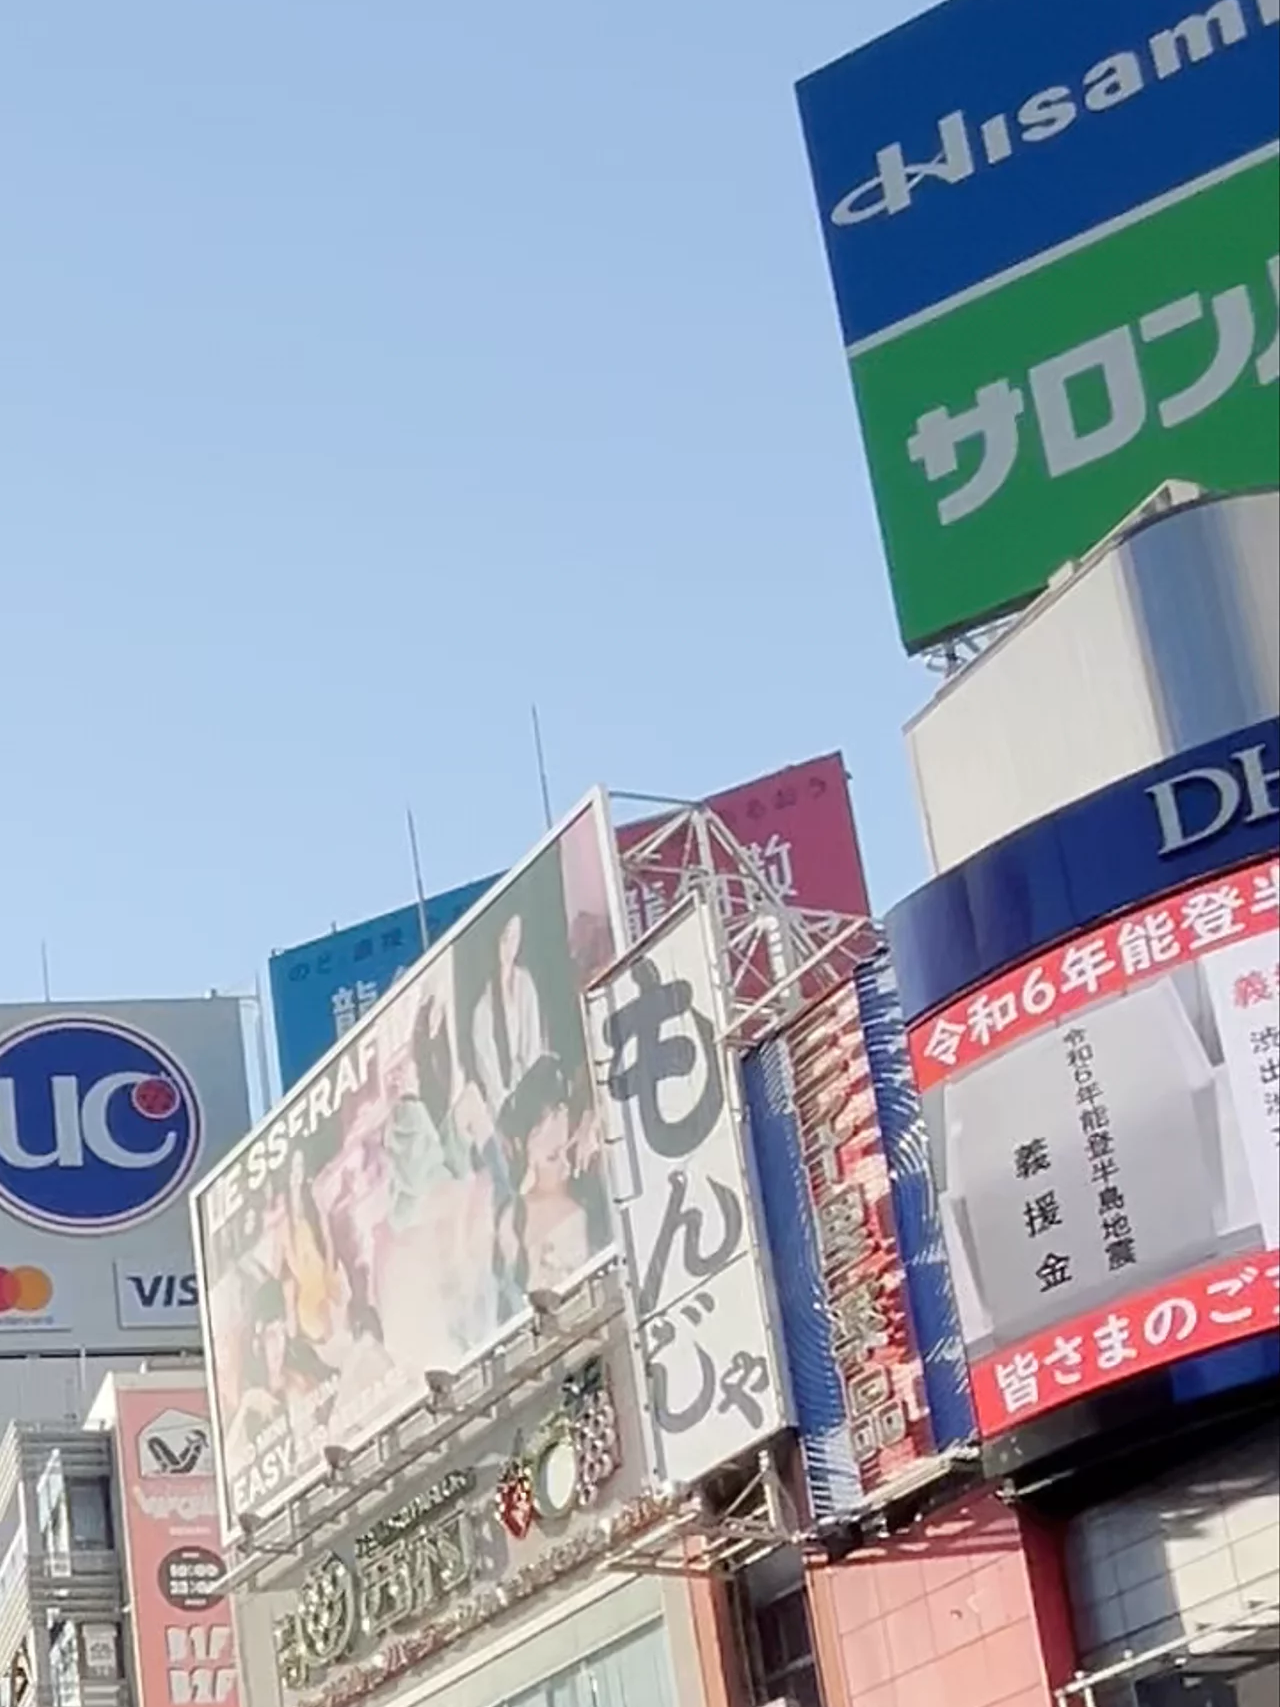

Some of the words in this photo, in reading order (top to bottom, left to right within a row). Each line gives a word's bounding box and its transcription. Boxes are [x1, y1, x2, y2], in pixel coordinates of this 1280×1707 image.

[607, 956, 774, 1434] もんじゃ
[1014, 1136, 1072, 1294] 義援金
[1062, 1026, 1137, 1272] 令和6年能登半島地震
